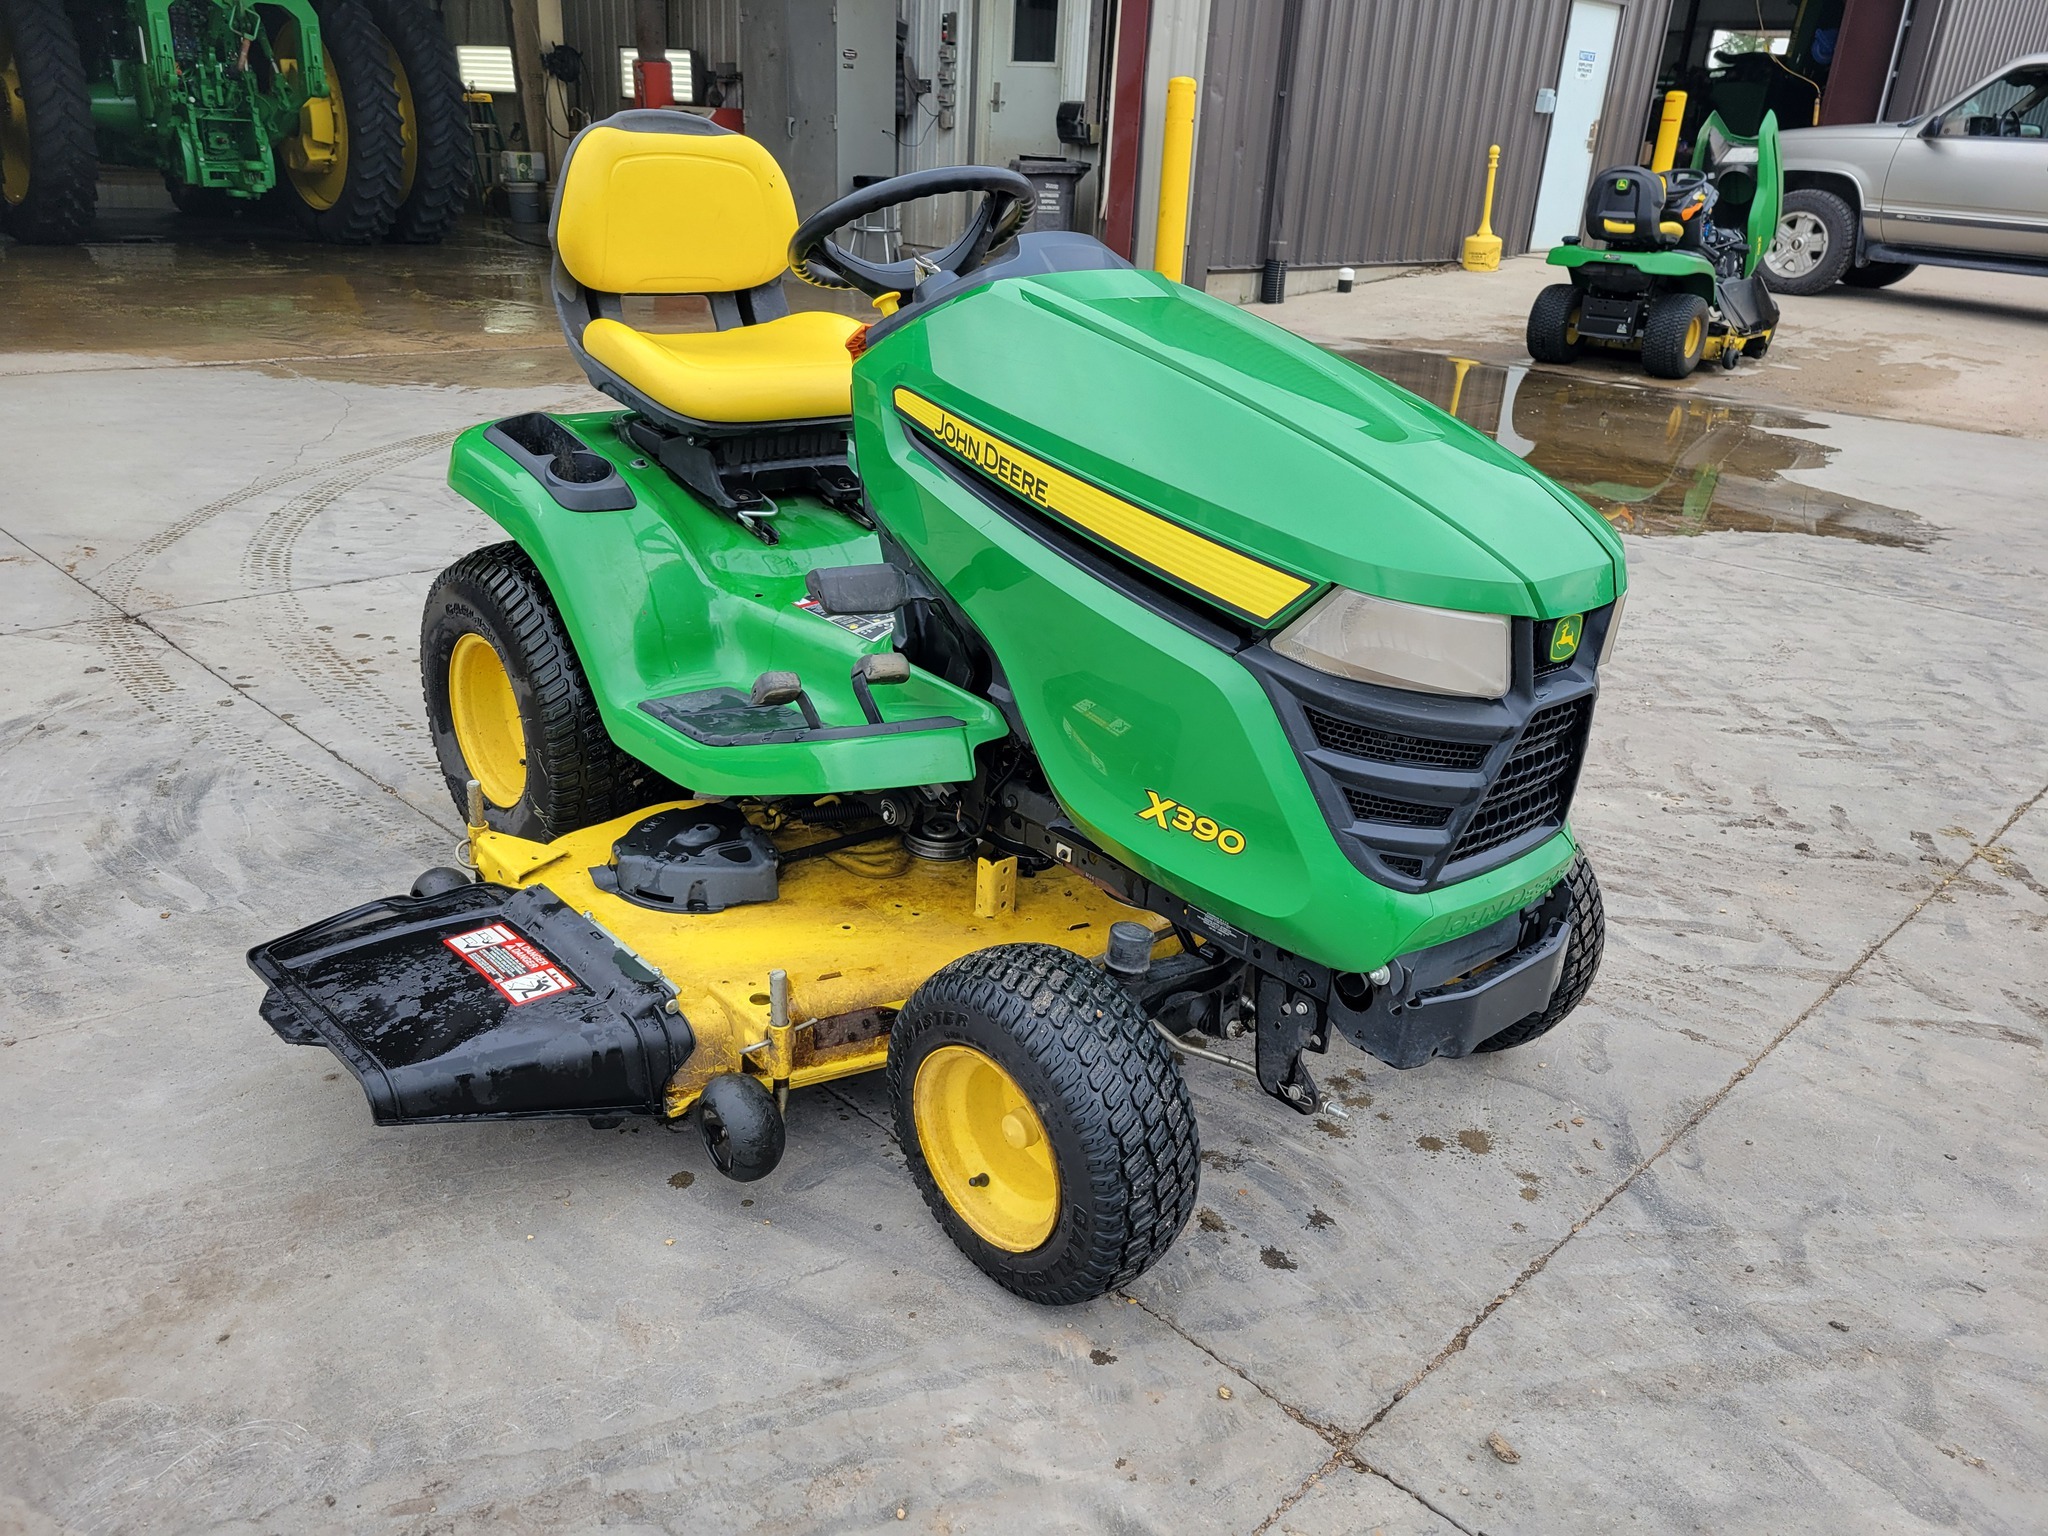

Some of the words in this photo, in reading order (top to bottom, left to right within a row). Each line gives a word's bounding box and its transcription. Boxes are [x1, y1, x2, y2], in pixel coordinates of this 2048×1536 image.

[934, 413, 981, 462] JOHN
[983, 441, 1049, 504] DEERE
[1134, 788, 1247, 855] X390
[511, 948, 539, 970] DANGER
[521, 945, 549, 967] DANGER
